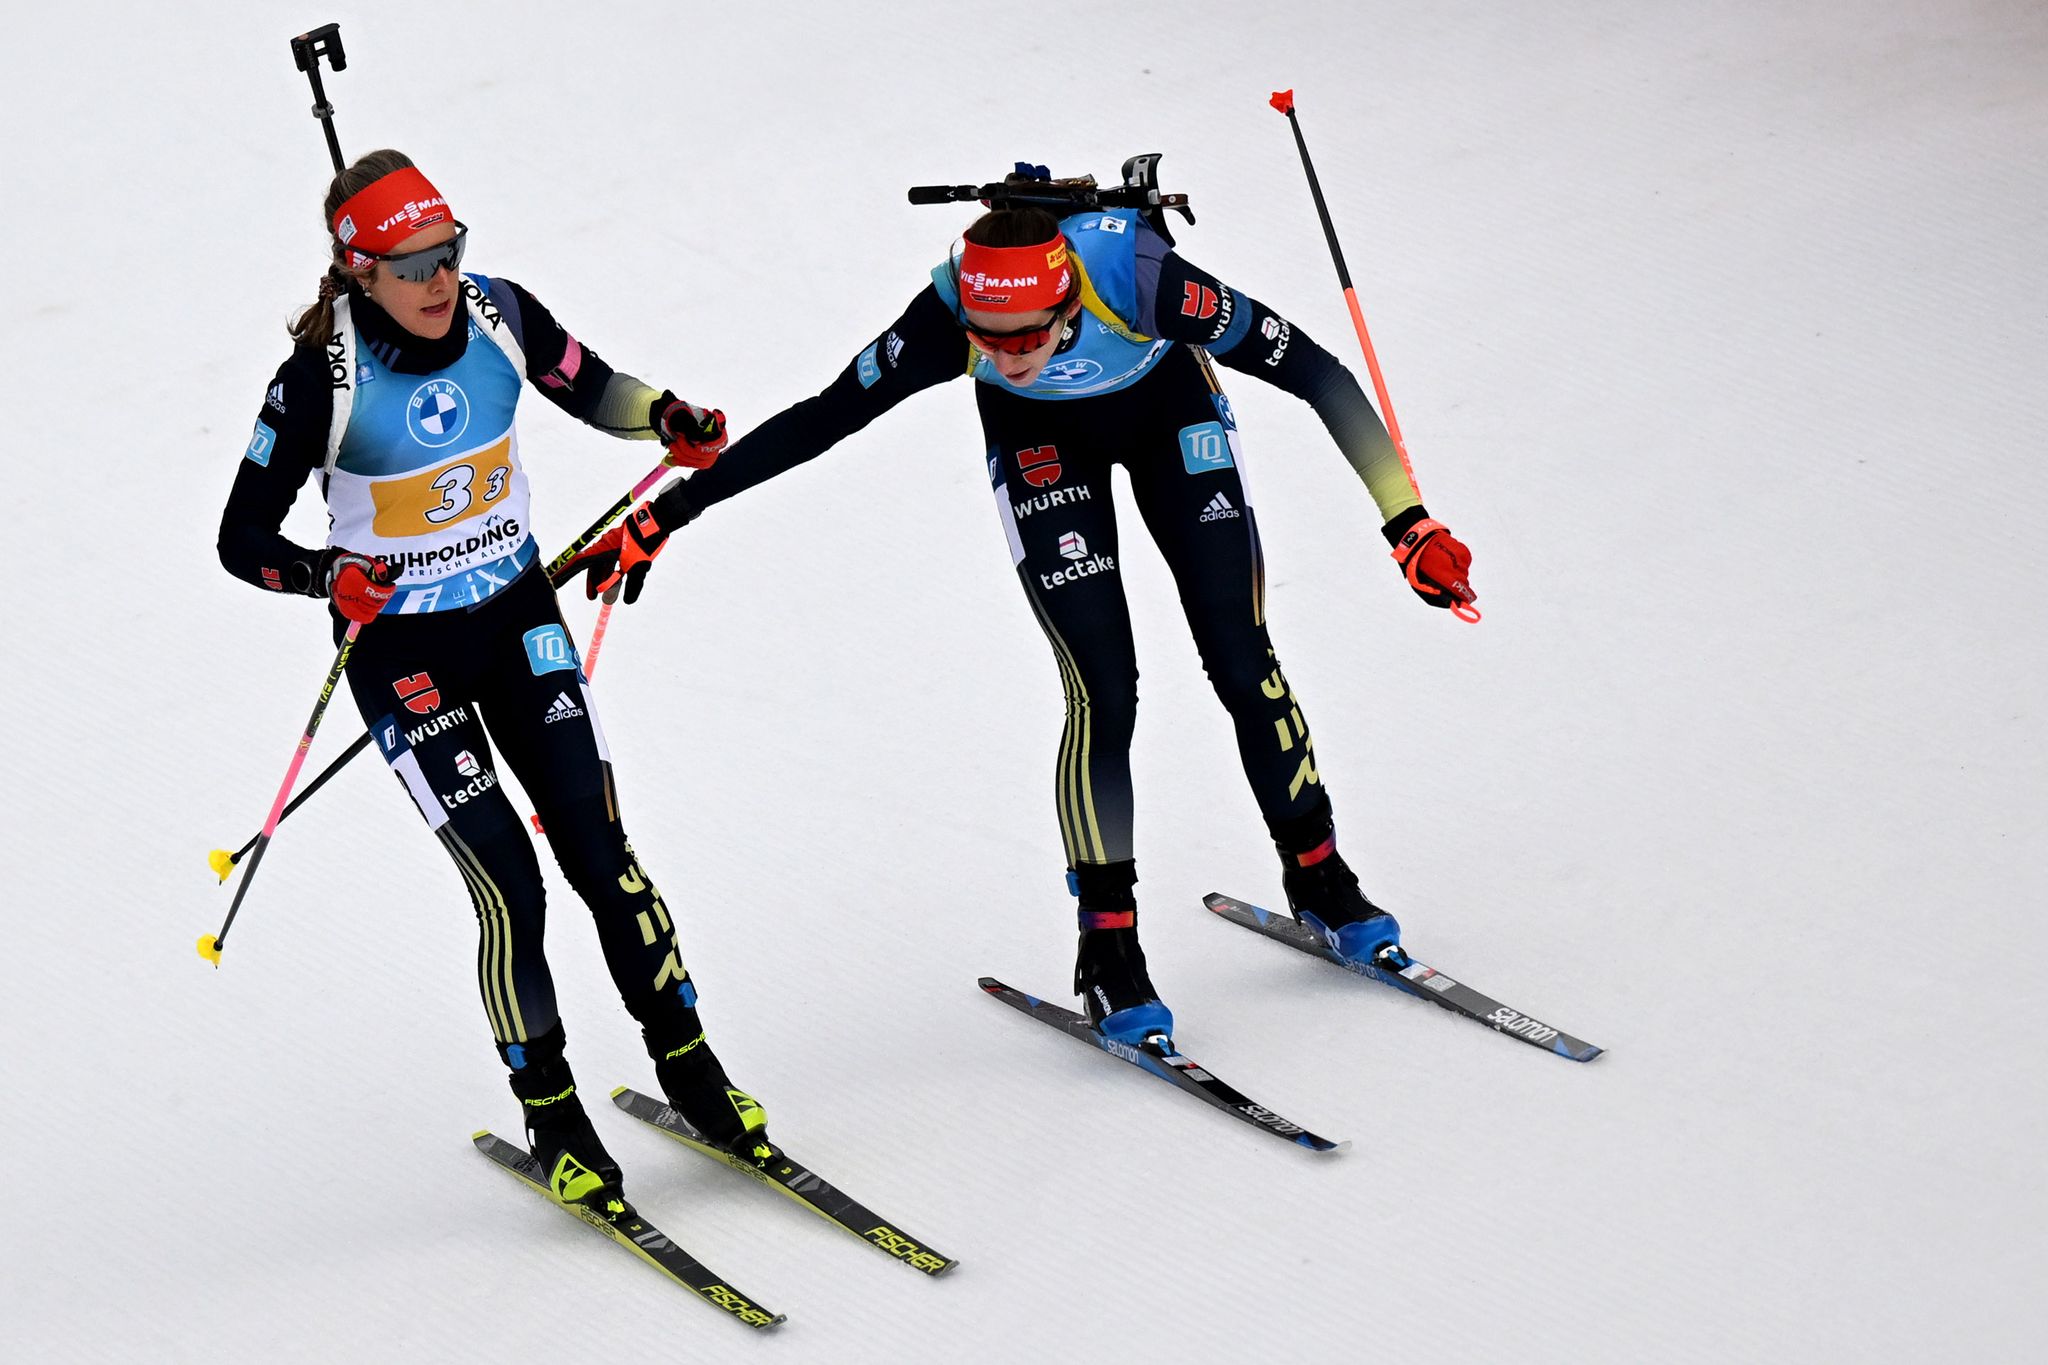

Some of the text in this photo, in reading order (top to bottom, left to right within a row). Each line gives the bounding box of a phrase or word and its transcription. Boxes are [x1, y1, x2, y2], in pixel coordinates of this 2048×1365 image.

[961, 271, 1038, 292] VIESSMANN
[328, 331, 351, 391] JOKA
[412, 383, 456, 409] BMW
[424, 463, 510, 526] 3 3
[1014, 484, 1092, 519] WÜRTH
[1199, 508, 1240, 523] adidas
[1040, 553, 1115, 590] tectake
[531, 631, 569, 664] TQ
[404, 707, 469, 748] WÜRTH
[544, 708, 584, 724] adidas
[524, 1084, 574, 1107] FISCHER
[863, 1225, 946, 1274] FISCHER
[700, 1284, 773, 1329] FISCHER
